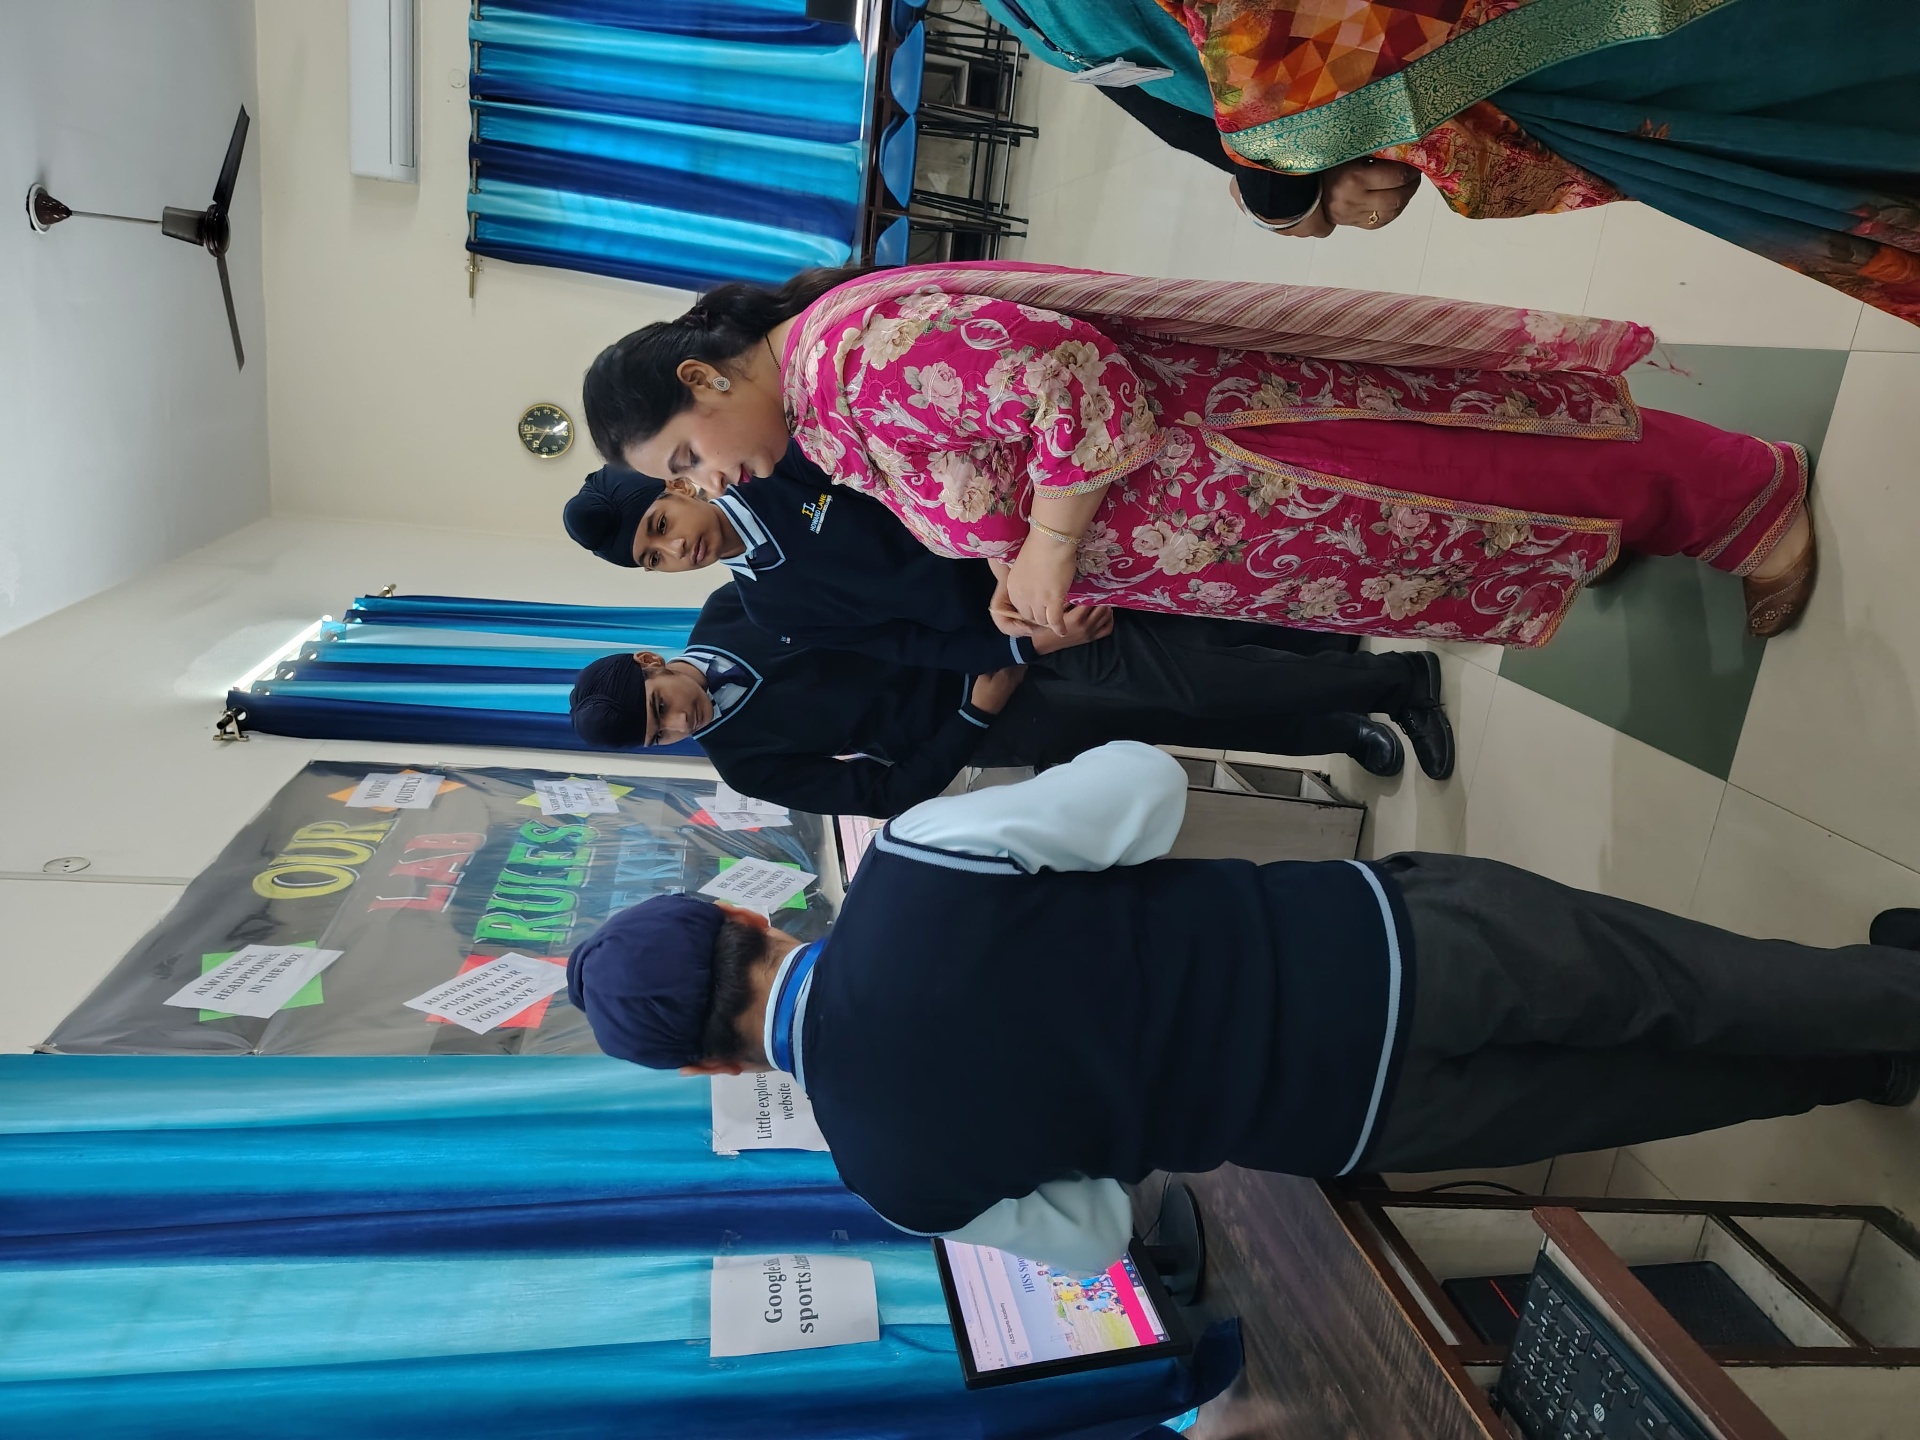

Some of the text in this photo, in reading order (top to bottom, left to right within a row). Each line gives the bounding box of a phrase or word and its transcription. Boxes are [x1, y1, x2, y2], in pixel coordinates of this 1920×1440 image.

[816, 494, 826, 510] LANE
[365, 780, 390, 799] WORK
[394, 776, 422, 804] QUIETLY
[252, 818, 399, 899] OUR
[368, 832, 487, 912] LAB
[473, 822, 600, 944] RULES
[194, 954, 257, 996] ALWAYS PUT
[213, 953, 281, 1000] HEADPHONES
[248, 952, 304, 994] IN THE BOX
[424, 972, 490, 1006] REMEMBER
[440, 994, 474, 1010] PUSH
[486, 970, 522, 988] YOUR
[456, 976, 533, 1016] CHAIR, WHEN
[470, 988, 537, 1024] YOU LEAVE
[778, 1083, 794, 1120] website
[756, 1110, 772, 1140] Little
[763, 1267, 787, 1323] Google
[796, 1272, 818, 1334] sports
[1594, 1404, 1604, 1420] hp
